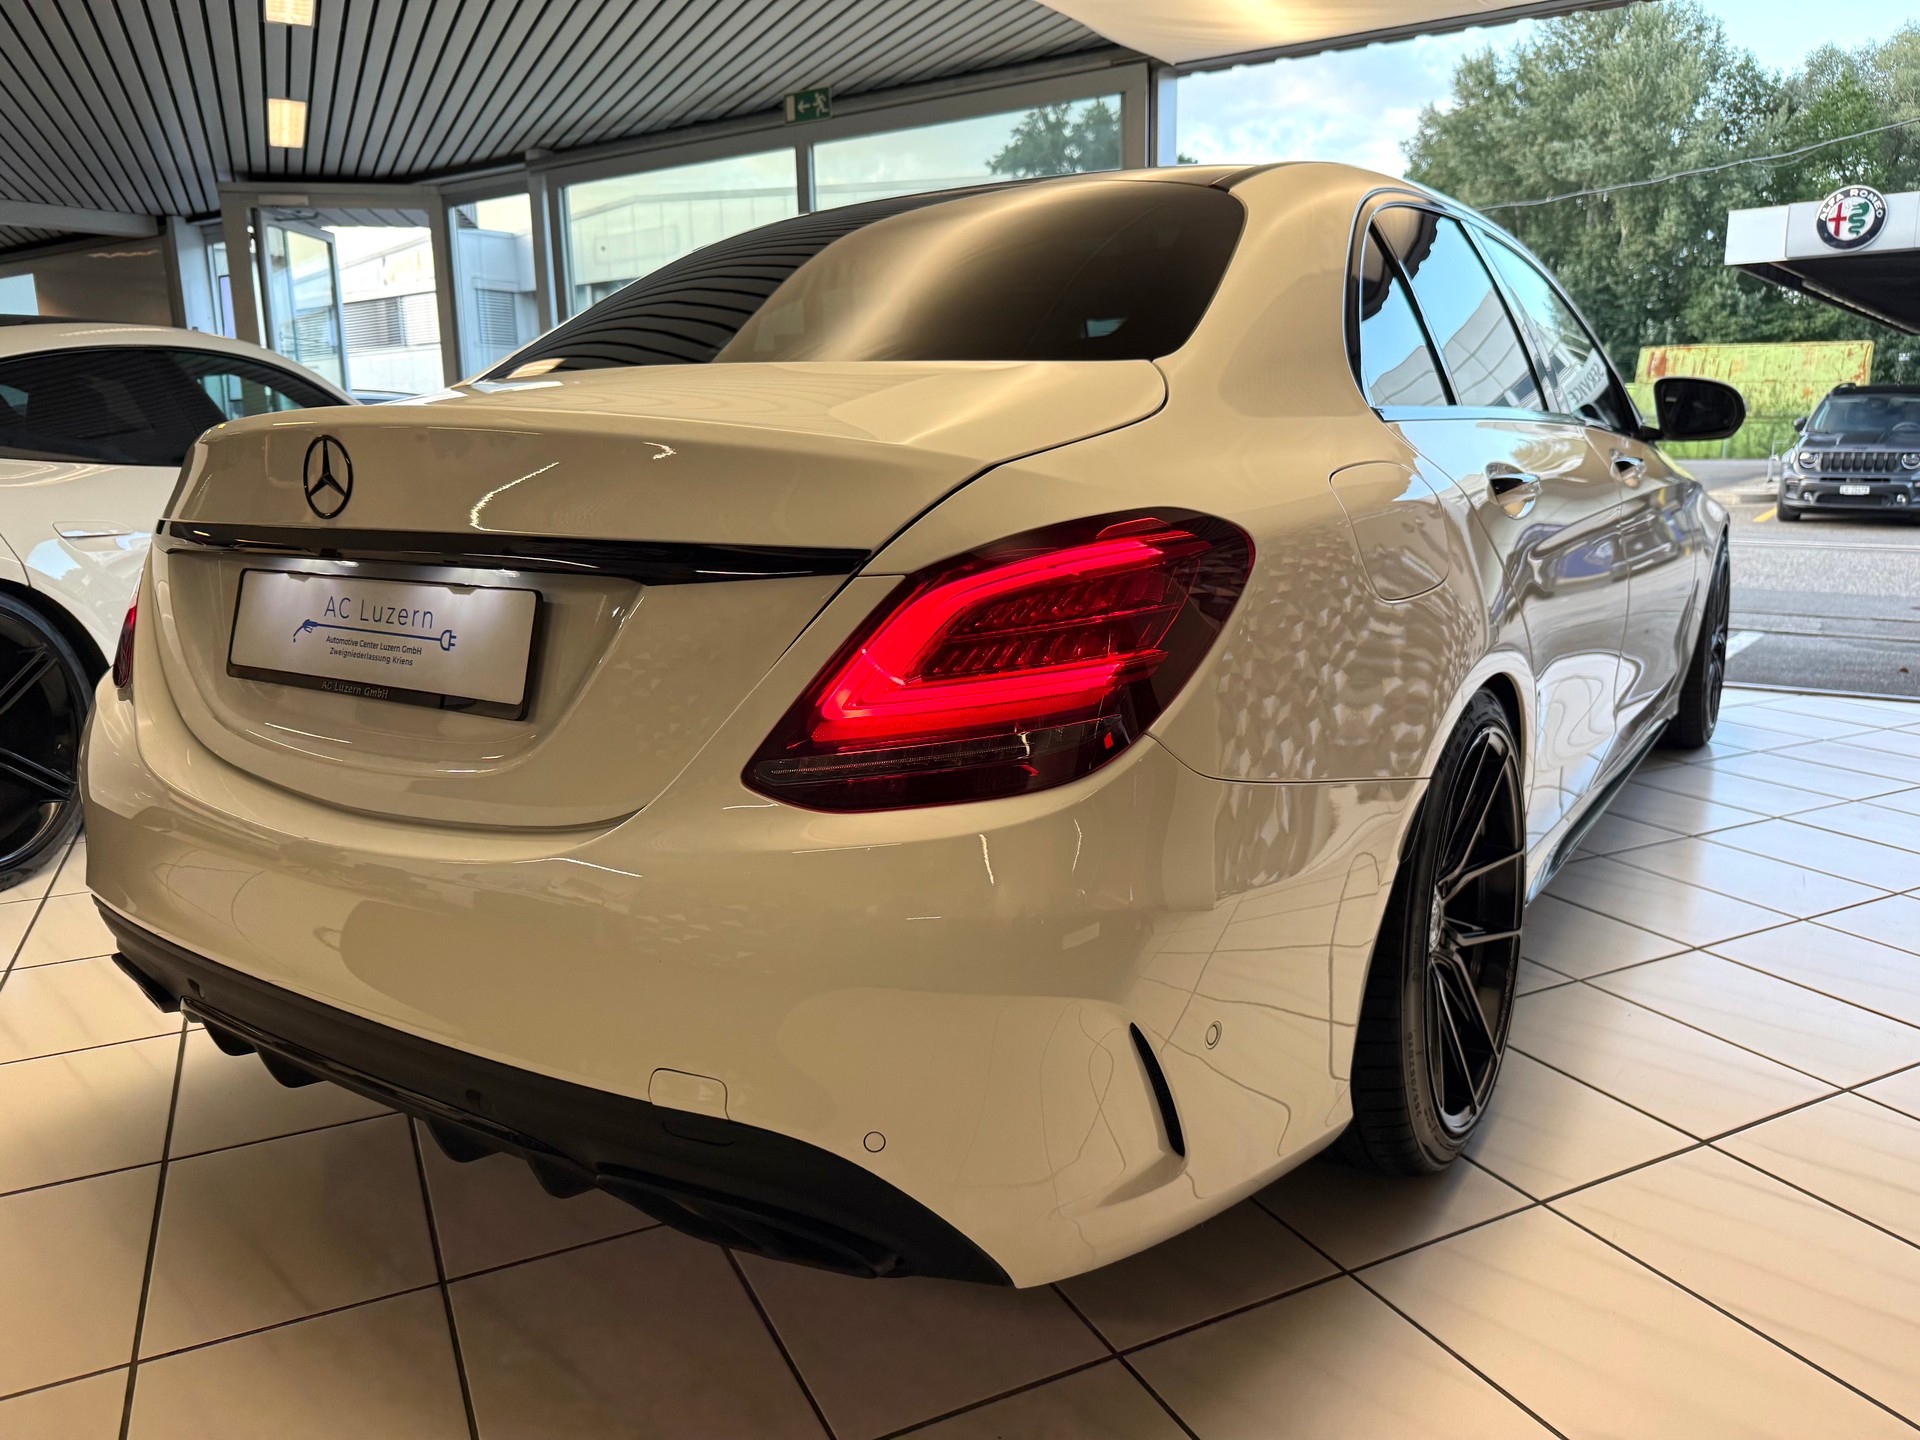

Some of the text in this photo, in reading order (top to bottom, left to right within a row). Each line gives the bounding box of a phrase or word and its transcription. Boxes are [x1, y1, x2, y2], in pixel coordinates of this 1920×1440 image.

[1820, 189, 1883, 221] ALFA ROMEO
[324, 596, 433, 629] AC Luzern
[326, 636, 423, 655] Automotive Center Luzern GmbH
[329, 647, 413, 666] Zweigniederlassung Kriens
[322, 681, 389, 699] AC Luzern GmbH
